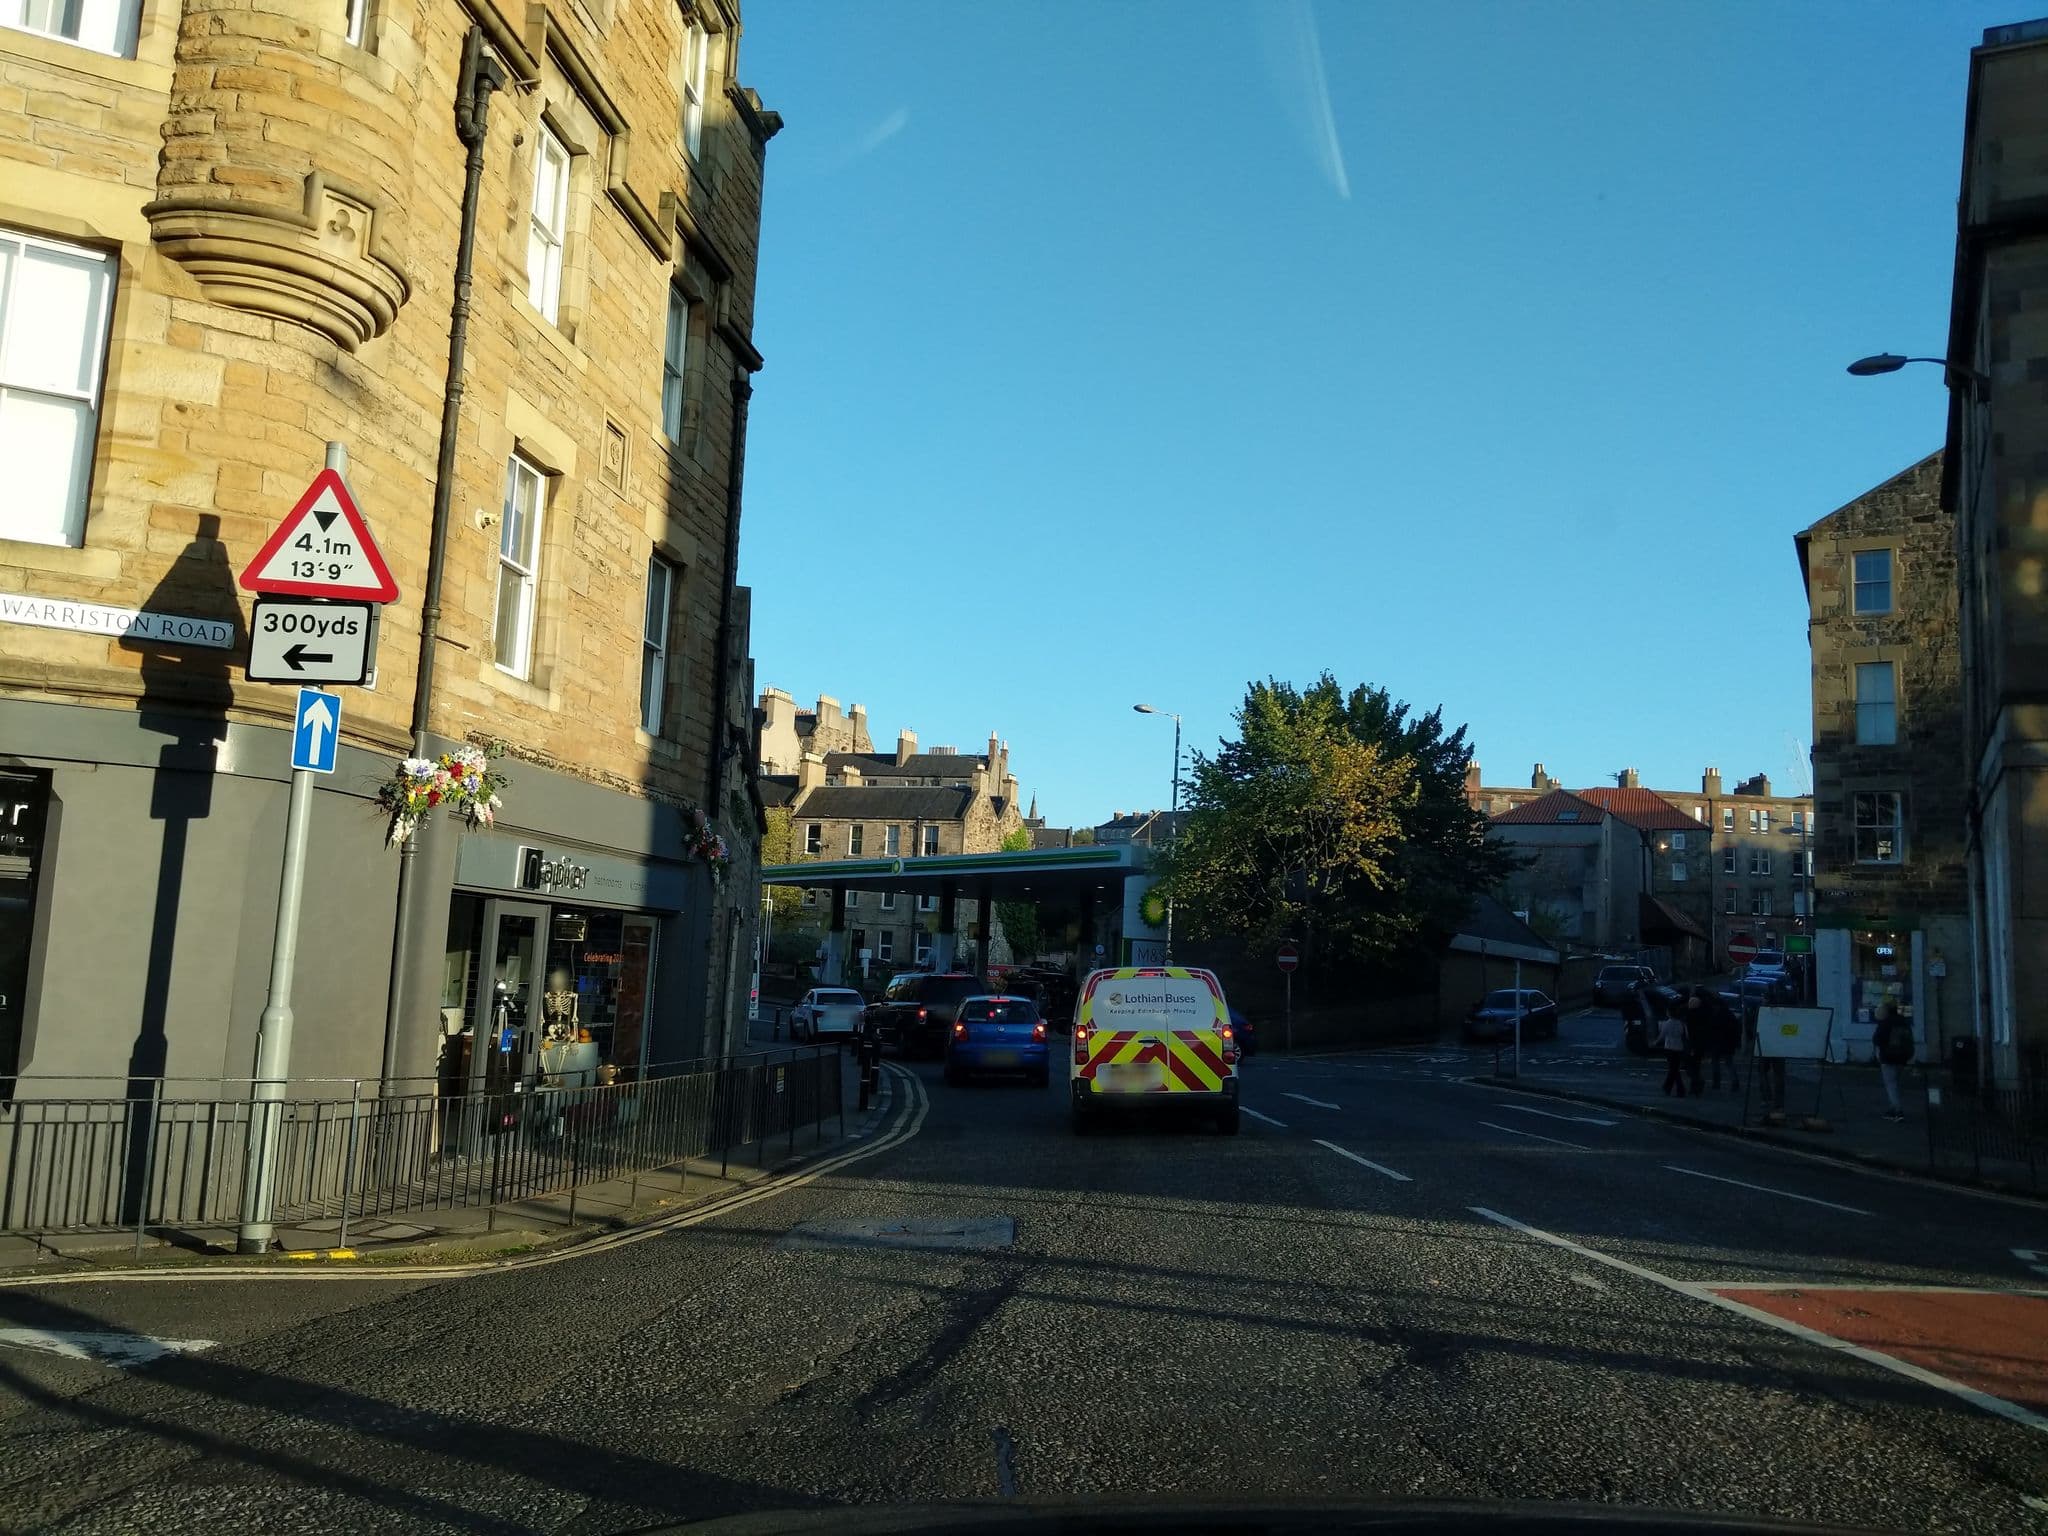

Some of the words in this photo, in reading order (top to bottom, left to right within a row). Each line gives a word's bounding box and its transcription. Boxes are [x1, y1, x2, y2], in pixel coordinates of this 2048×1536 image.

[294, 532, 351, 556] 4.1m
[2, 599, 151, 632] WARRISTON
[161, 621, 227, 642] ROAD
[263, 613, 359, 638] 300yds
[1876, 947, 1893, 955] OPEN
[1125, 993, 1164, 1004] Lothian
[1165, 993, 1196, 1004] Buses
